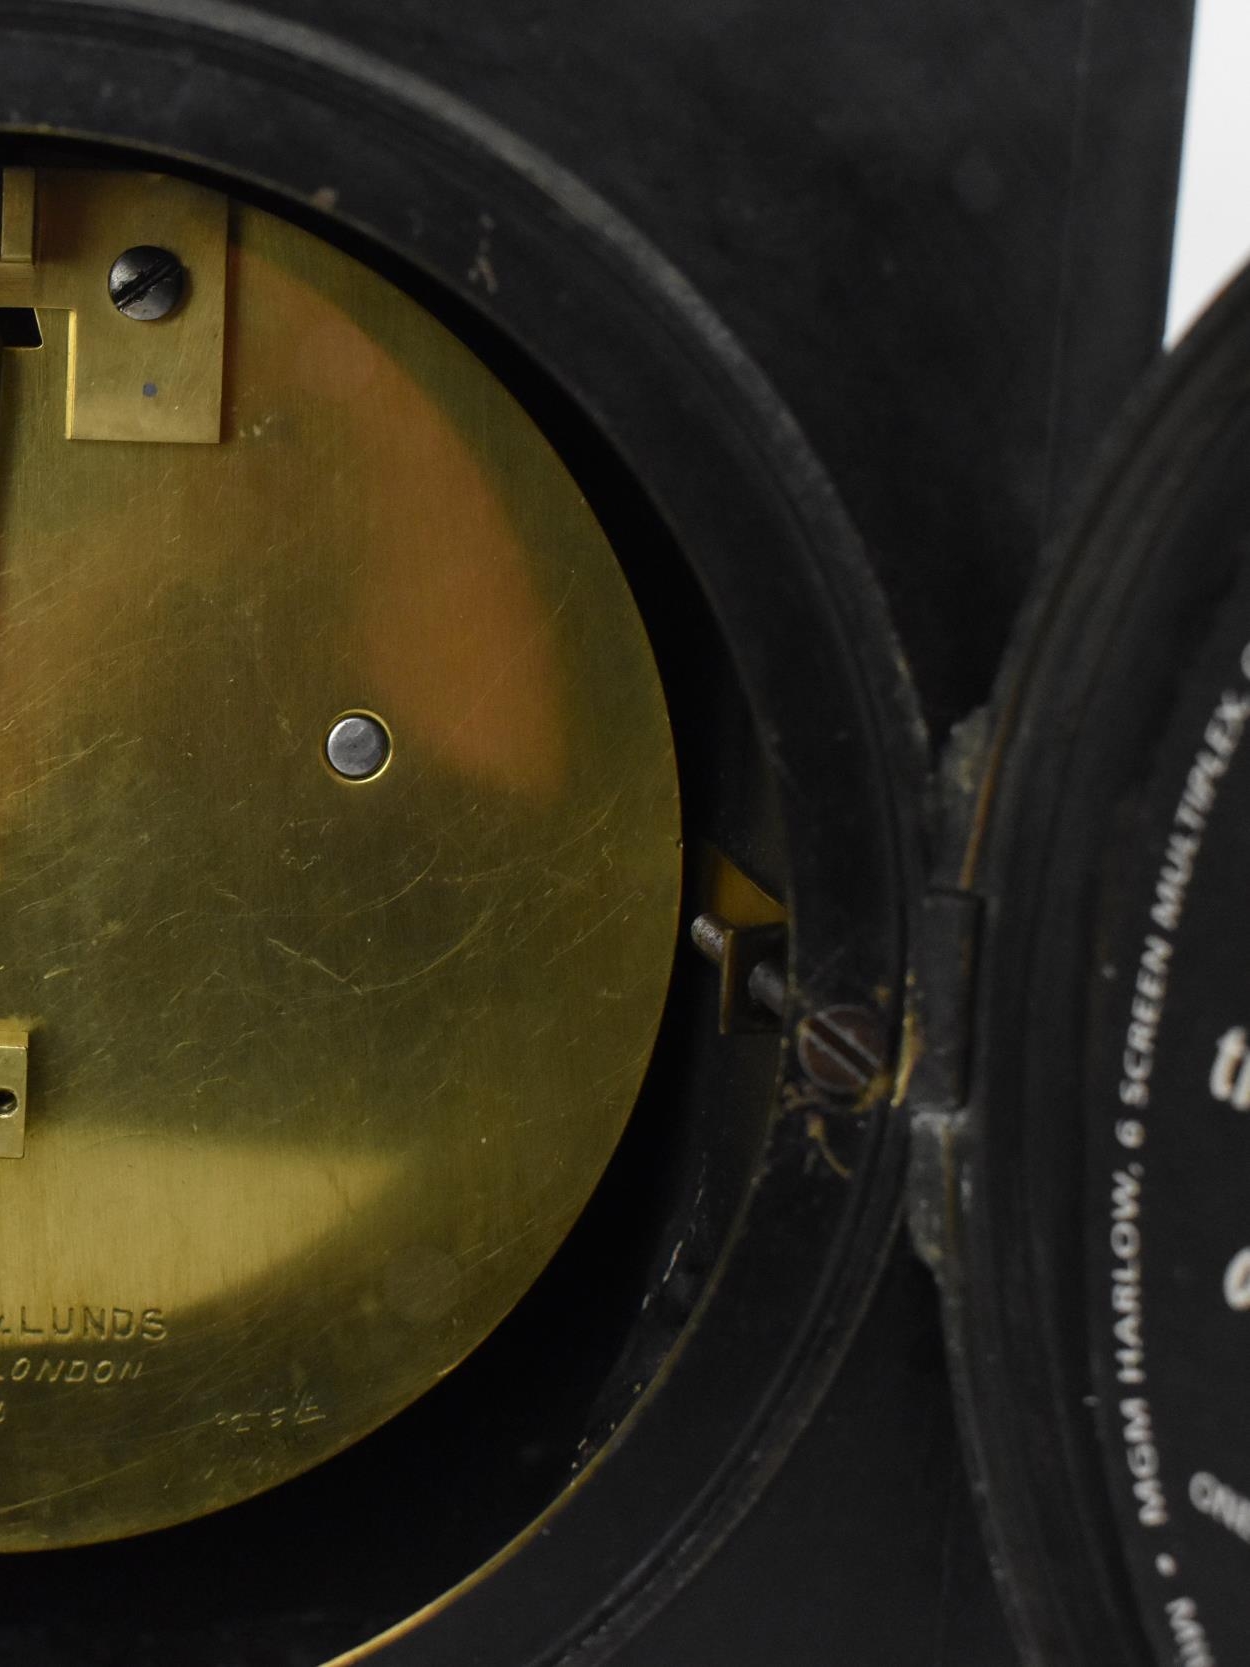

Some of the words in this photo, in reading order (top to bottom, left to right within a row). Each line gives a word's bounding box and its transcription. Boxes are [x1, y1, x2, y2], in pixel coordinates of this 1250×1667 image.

[1151, 692, 1250, 930] MULTIPLEX
[1119, 934, 1173, 1108] SCREEN
[1115, 1119, 1144, 1149] 6
[18, 1304, 168, 1341] LUNDS
[1119, 1397, 1168, 1526] MGM
